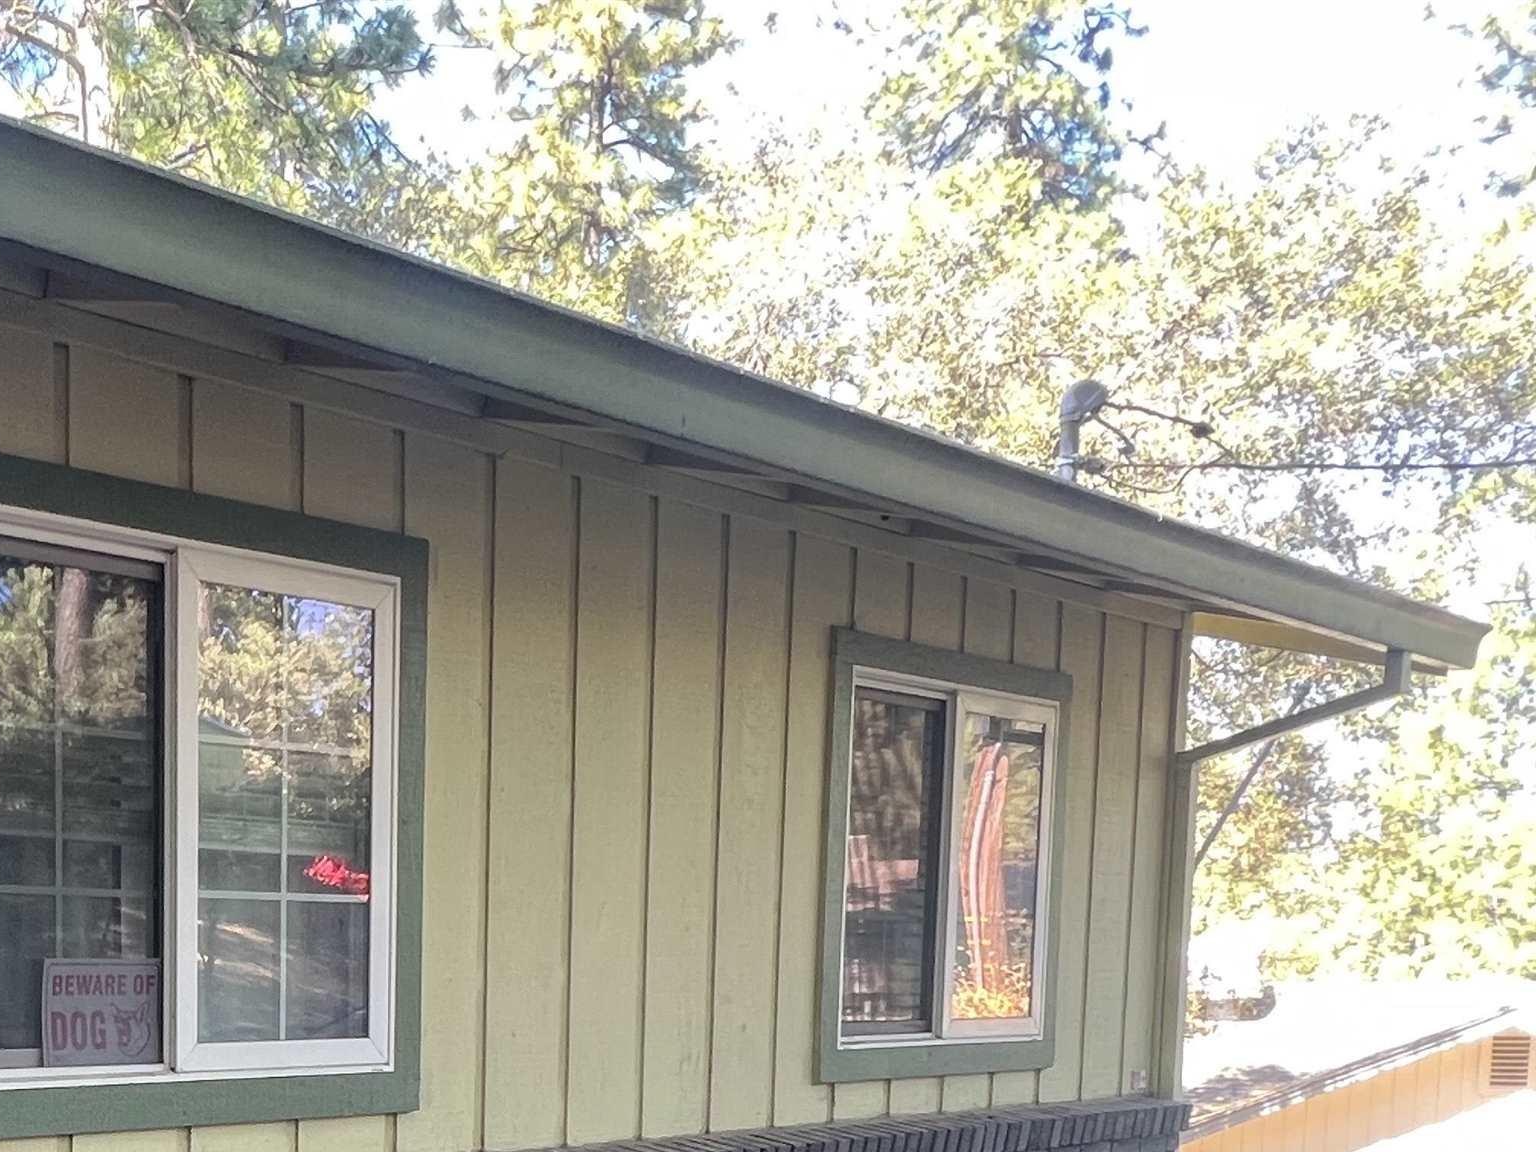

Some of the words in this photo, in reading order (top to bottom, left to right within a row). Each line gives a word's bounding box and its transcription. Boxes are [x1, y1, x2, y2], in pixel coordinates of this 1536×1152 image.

[52, 974, 127, 996] BEWARE
[133, 974, 157, 996] OF
[50, 1010, 107, 1051] DOG
